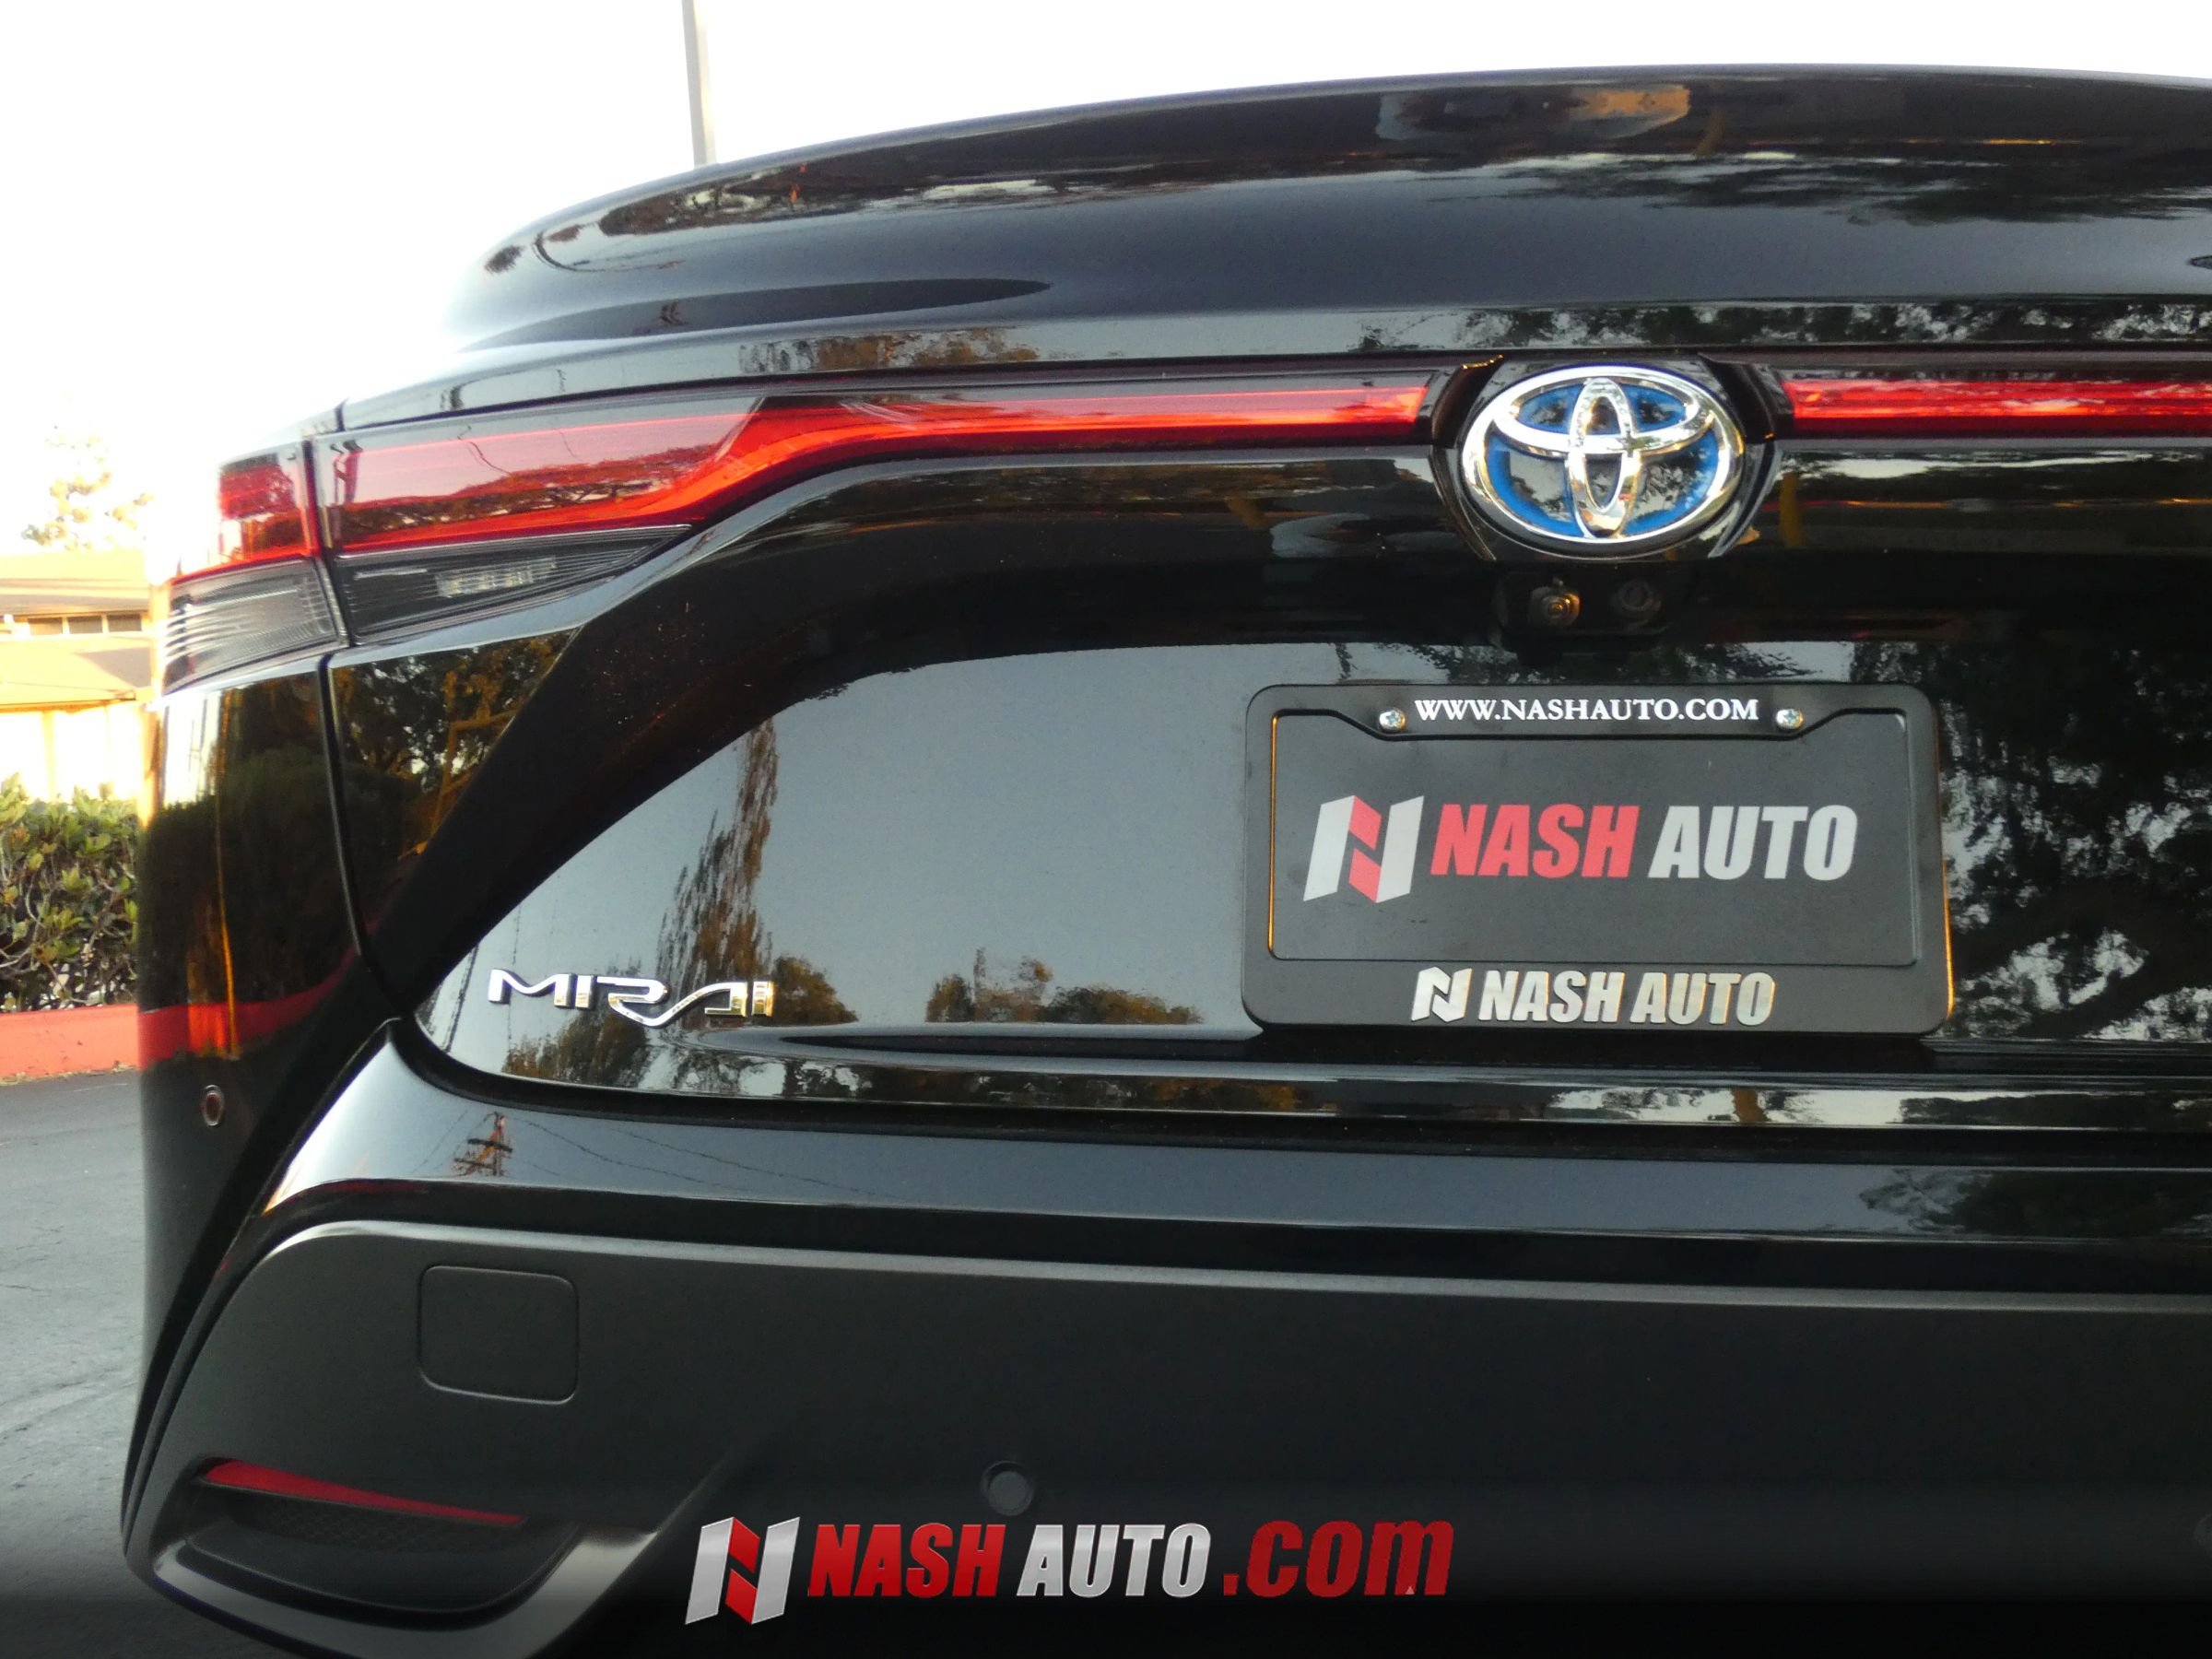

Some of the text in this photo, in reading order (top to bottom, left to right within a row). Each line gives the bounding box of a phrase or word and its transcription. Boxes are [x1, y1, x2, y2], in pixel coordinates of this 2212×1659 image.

[1414, 698, 1759, 723] WWW.NASHAUTO.COM
[1430, 803, 1641, 878] NASH
[1647, 804, 1858, 881] AUTO
[488, 968, 775, 1028] MIRAI
[1477, 969, 1626, 1024] NASH
[1629, 971, 1776, 1026] AUTO
